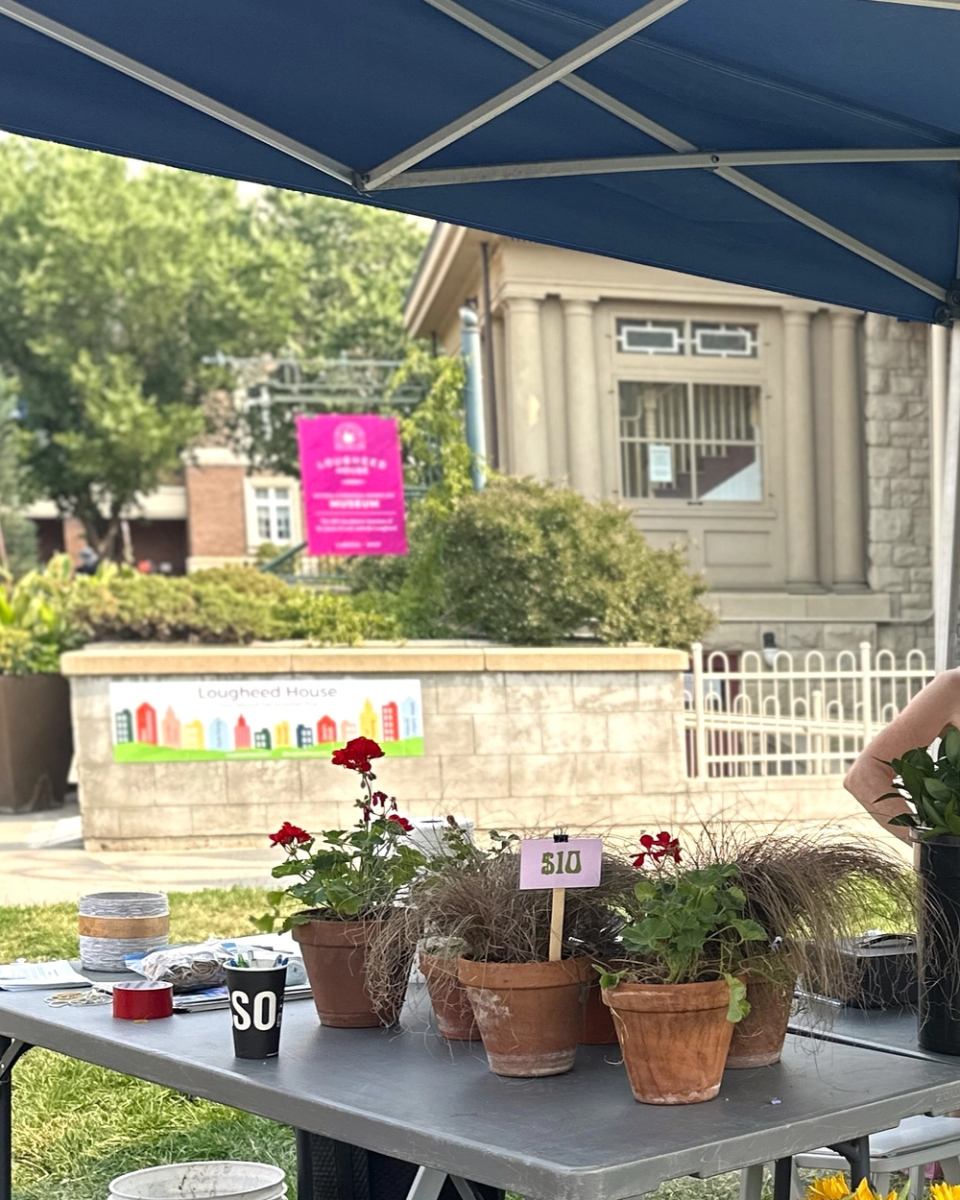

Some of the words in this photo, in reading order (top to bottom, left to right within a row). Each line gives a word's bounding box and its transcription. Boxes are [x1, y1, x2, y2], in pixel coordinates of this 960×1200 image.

[198, 686, 281, 701] Lougheed
[286, 686, 337, 698] House
[541, 850, 582, 875] $10
[231, 990, 277, 1031] SO
